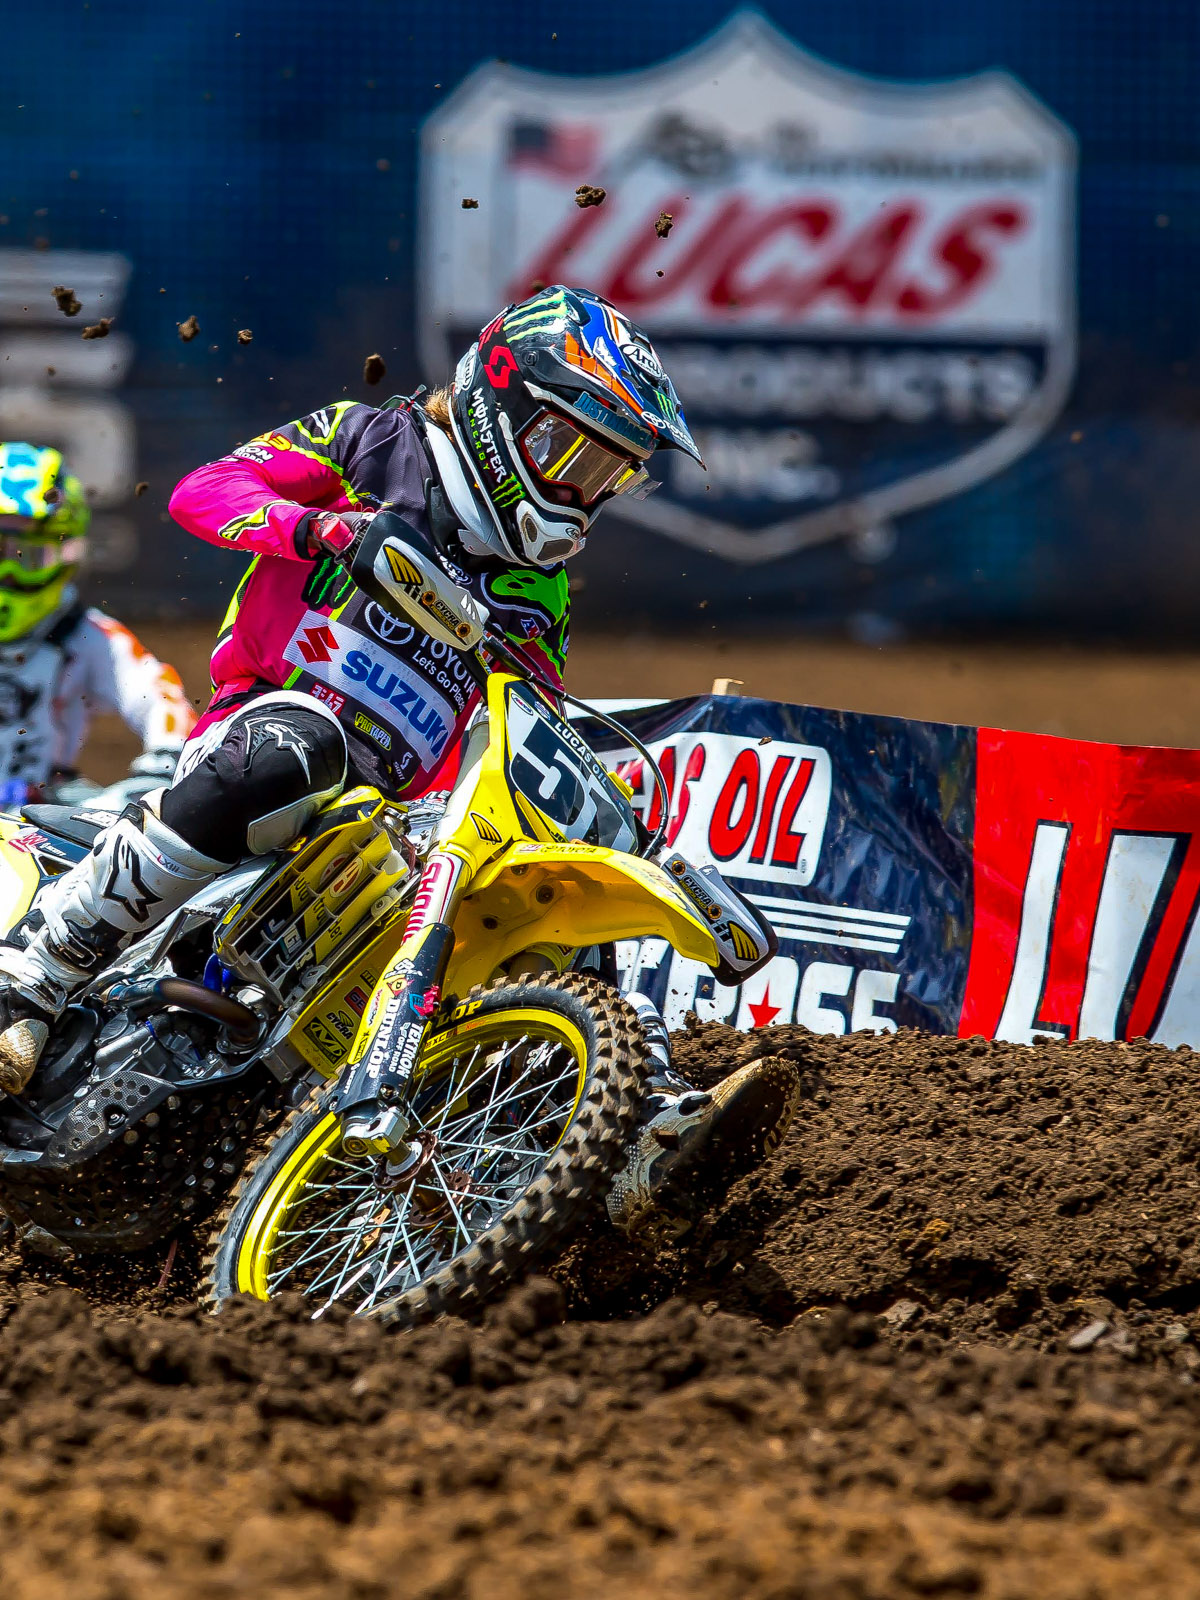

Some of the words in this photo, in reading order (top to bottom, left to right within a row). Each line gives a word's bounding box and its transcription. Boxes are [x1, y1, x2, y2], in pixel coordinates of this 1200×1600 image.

[507, 198, 1027, 323] LUCAS
[632, 347, 662, 376] Arai
[664, 347, 1034, 424] RODUCTS
[468, 408, 490, 471] ENERGY
[472, 387, 507, 483] MONSTER
[435, 601, 460, 627] CYCRA
[412, 650, 437, 676] Let's
[436, 670, 452, 690] Go
[356, 715, 392, 749] PROTAPER
[554, 721, 592, 764] LUCAS
[592, 763, 608, 788] OIL
[709, 748, 817, 870] OIL
[684, 876, 714, 906] CYCRA
[326, 1012, 354, 1040] CYCRA
[366, 997, 399, 1079] DUNLOP
[395, 1036, 405, 1054] OFF
[388, 1053, 401, 1072] ROAD
[397, 1022, 425, 1080] TEXTRON
